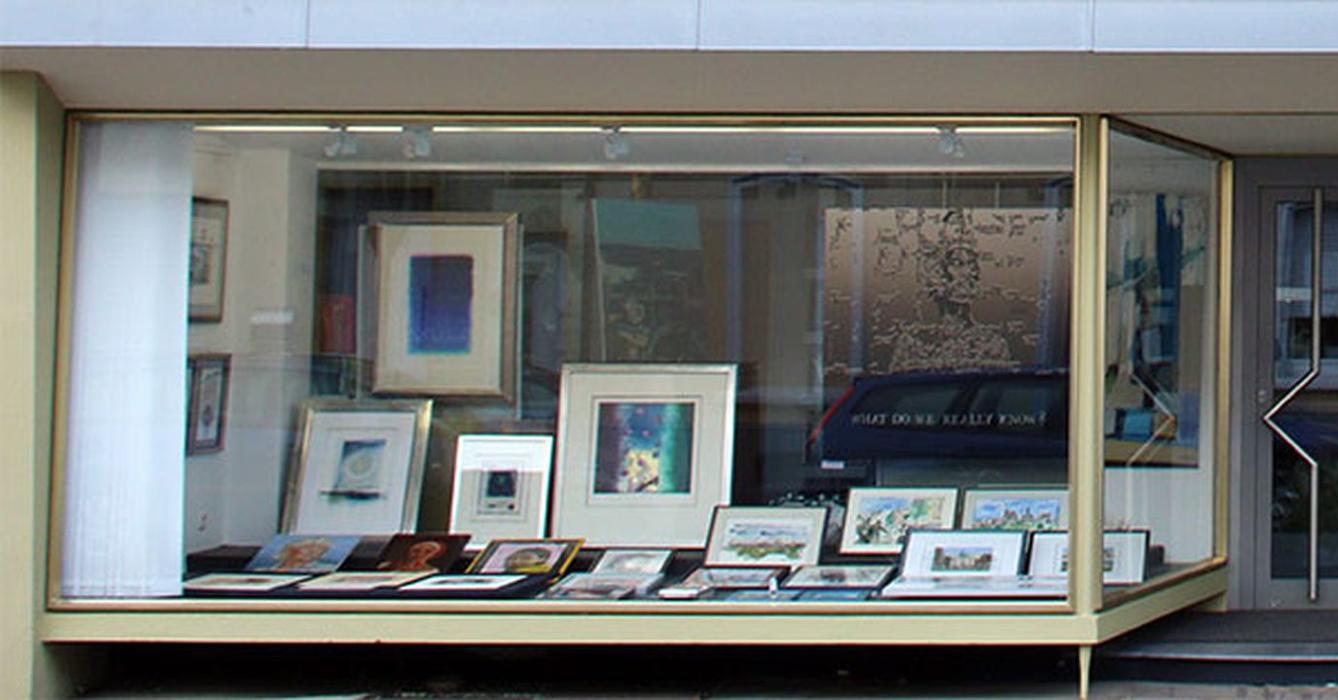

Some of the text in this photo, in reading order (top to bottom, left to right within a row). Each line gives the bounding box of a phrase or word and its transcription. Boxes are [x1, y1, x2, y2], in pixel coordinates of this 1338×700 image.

[852, 412, 886, 425] WHAT
[891, 412, 911, 425] DO
[915, 412, 934, 425] WE
[942, 412, 993, 425] REALLY
